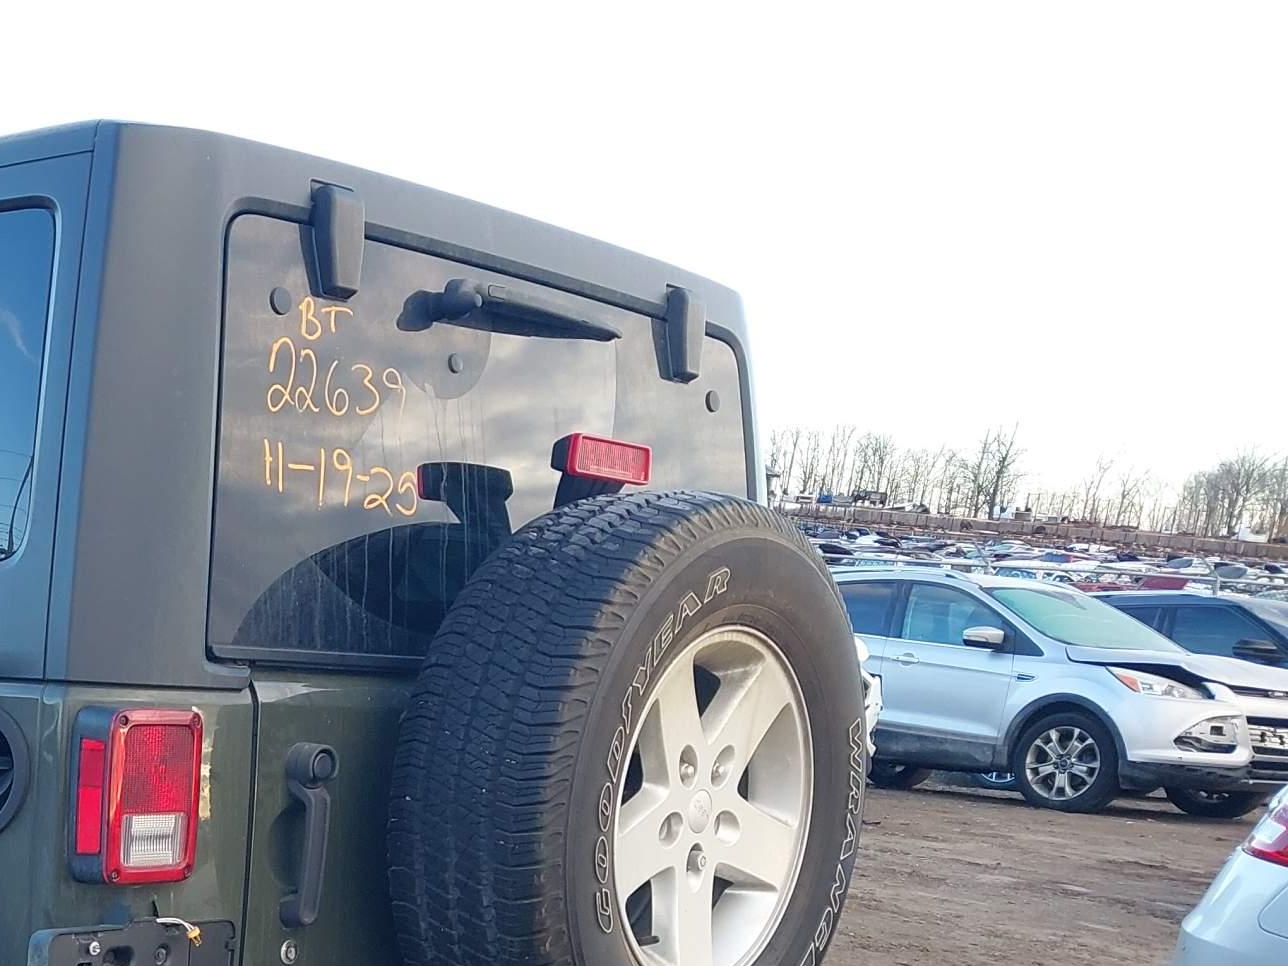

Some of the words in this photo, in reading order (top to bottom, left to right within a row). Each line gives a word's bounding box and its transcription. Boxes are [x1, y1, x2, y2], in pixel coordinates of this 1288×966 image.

[299, 296, 353, 340] BT
[267, 336, 407, 417] 22639
[595, 567, 731, 934] GOODYEAR
